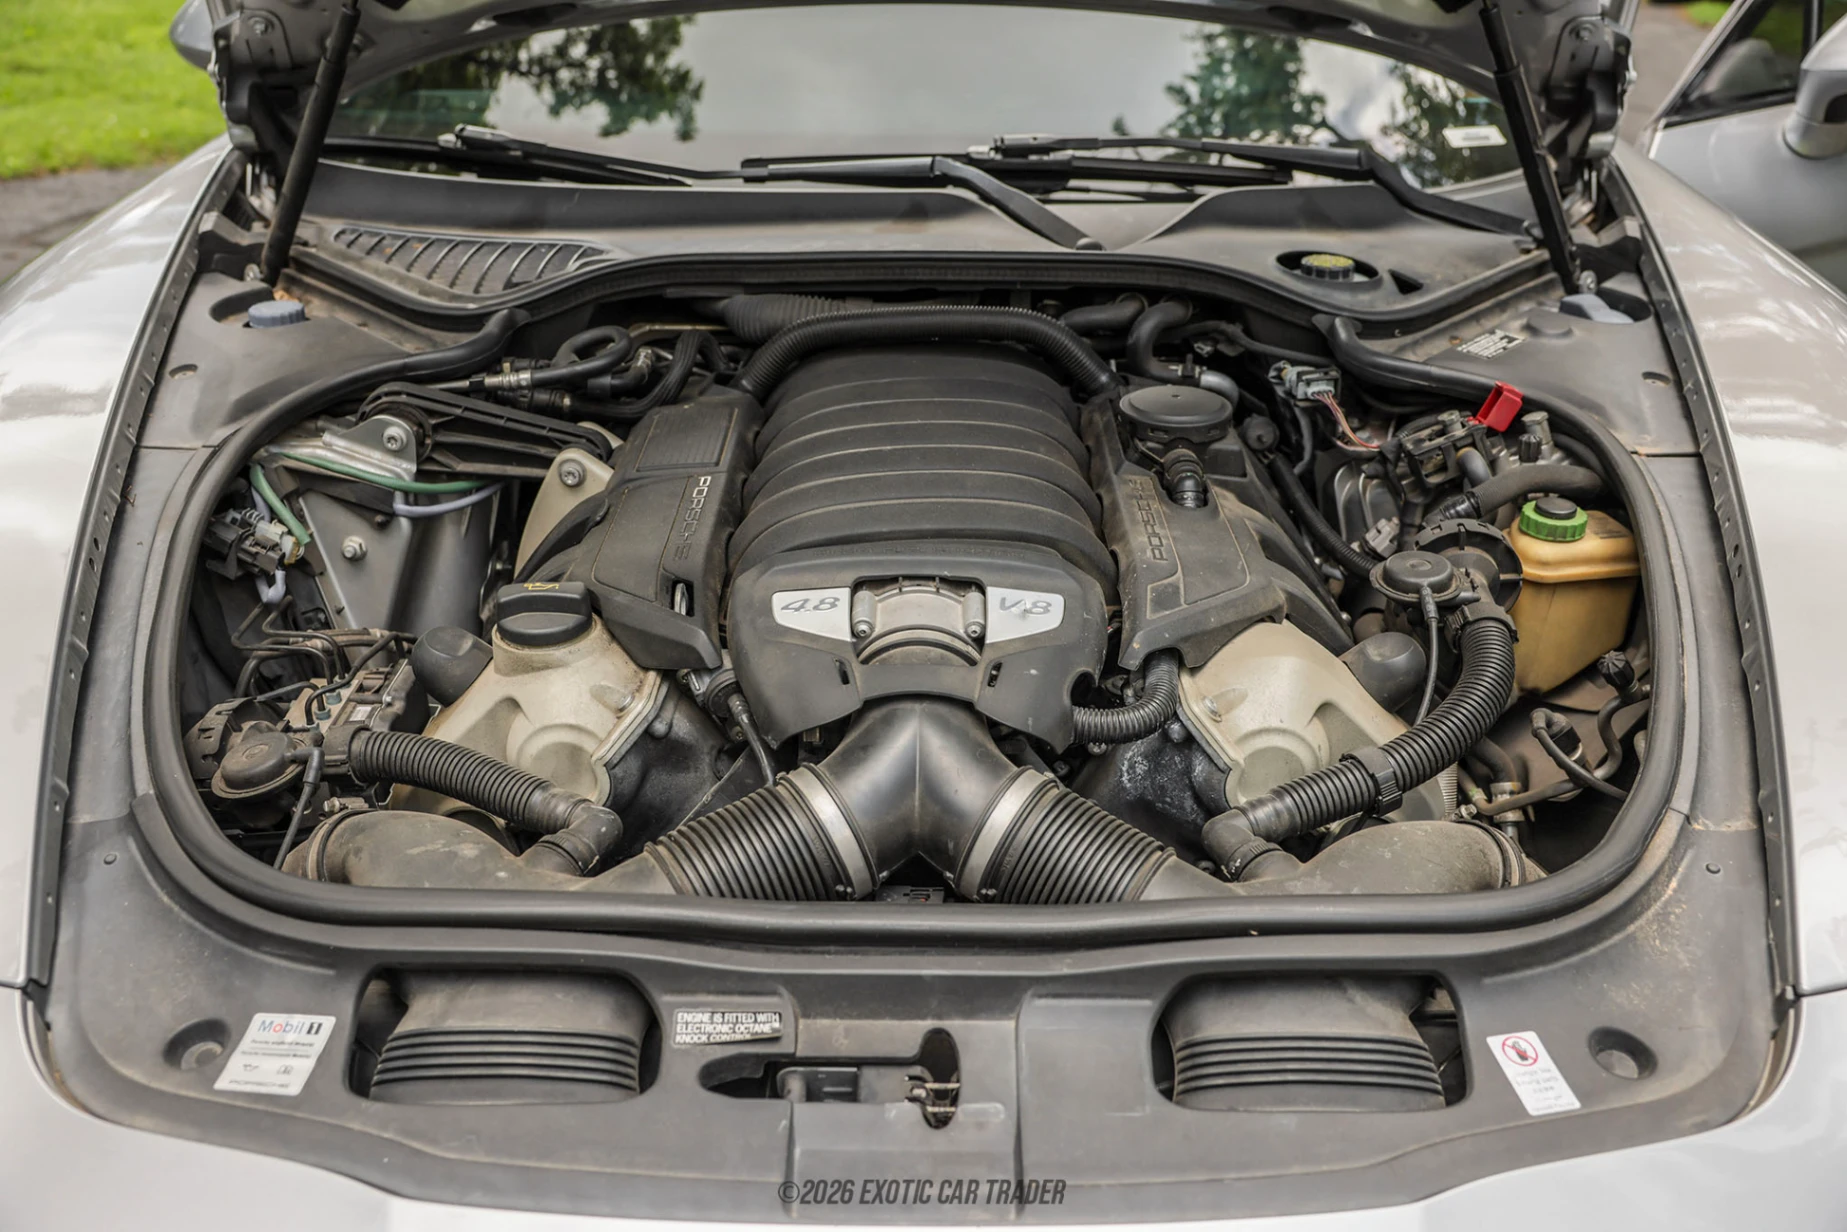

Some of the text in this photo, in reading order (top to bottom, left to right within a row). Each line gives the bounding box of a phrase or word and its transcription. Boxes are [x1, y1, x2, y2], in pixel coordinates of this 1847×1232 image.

[673, 475, 712, 561] PORSCHE
[780, 596, 841, 614] 4.8
[677, 1012, 780, 1023] ENGINE IS FITTED WITH
[257, 1019, 305, 1034] Mobil
[676, 1023, 733, 1034] ELECTRONIC
[675, 1034, 708, 1044] KNOCK
